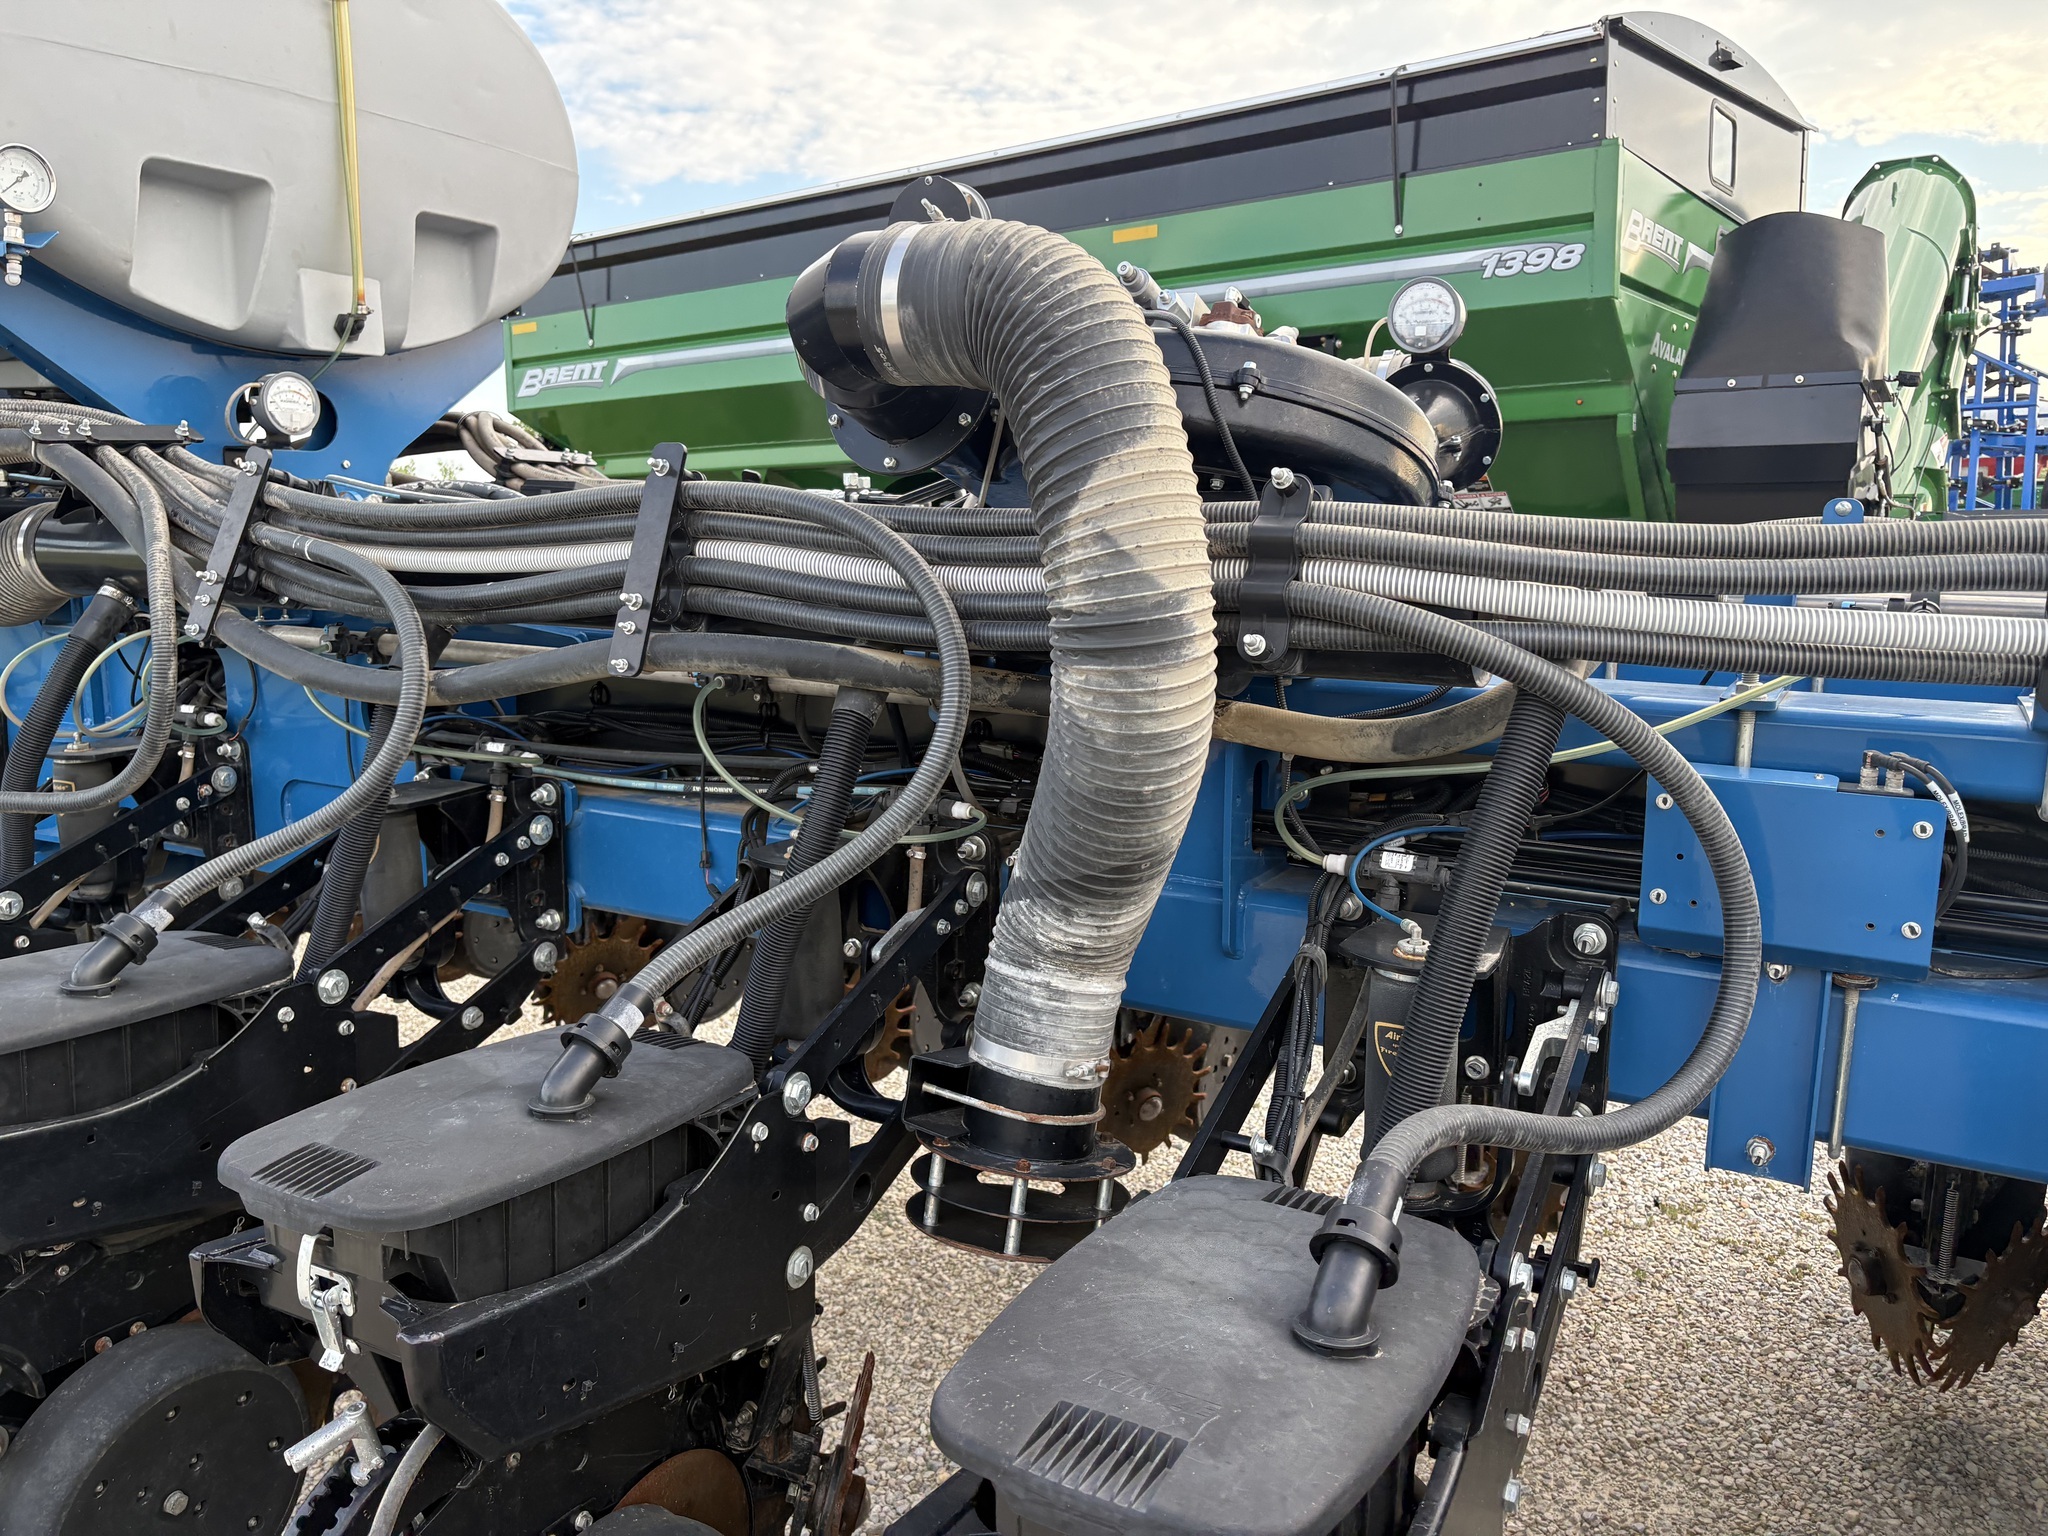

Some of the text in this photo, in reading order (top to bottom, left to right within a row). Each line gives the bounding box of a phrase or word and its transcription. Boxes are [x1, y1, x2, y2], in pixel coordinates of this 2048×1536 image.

[1621, 208, 1685, 261] BRENT
[1481, 243, 1586, 279] 1398
[516, 360, 609, 398] BRENT
[692, 785, 734, 794] ARMORCAT
